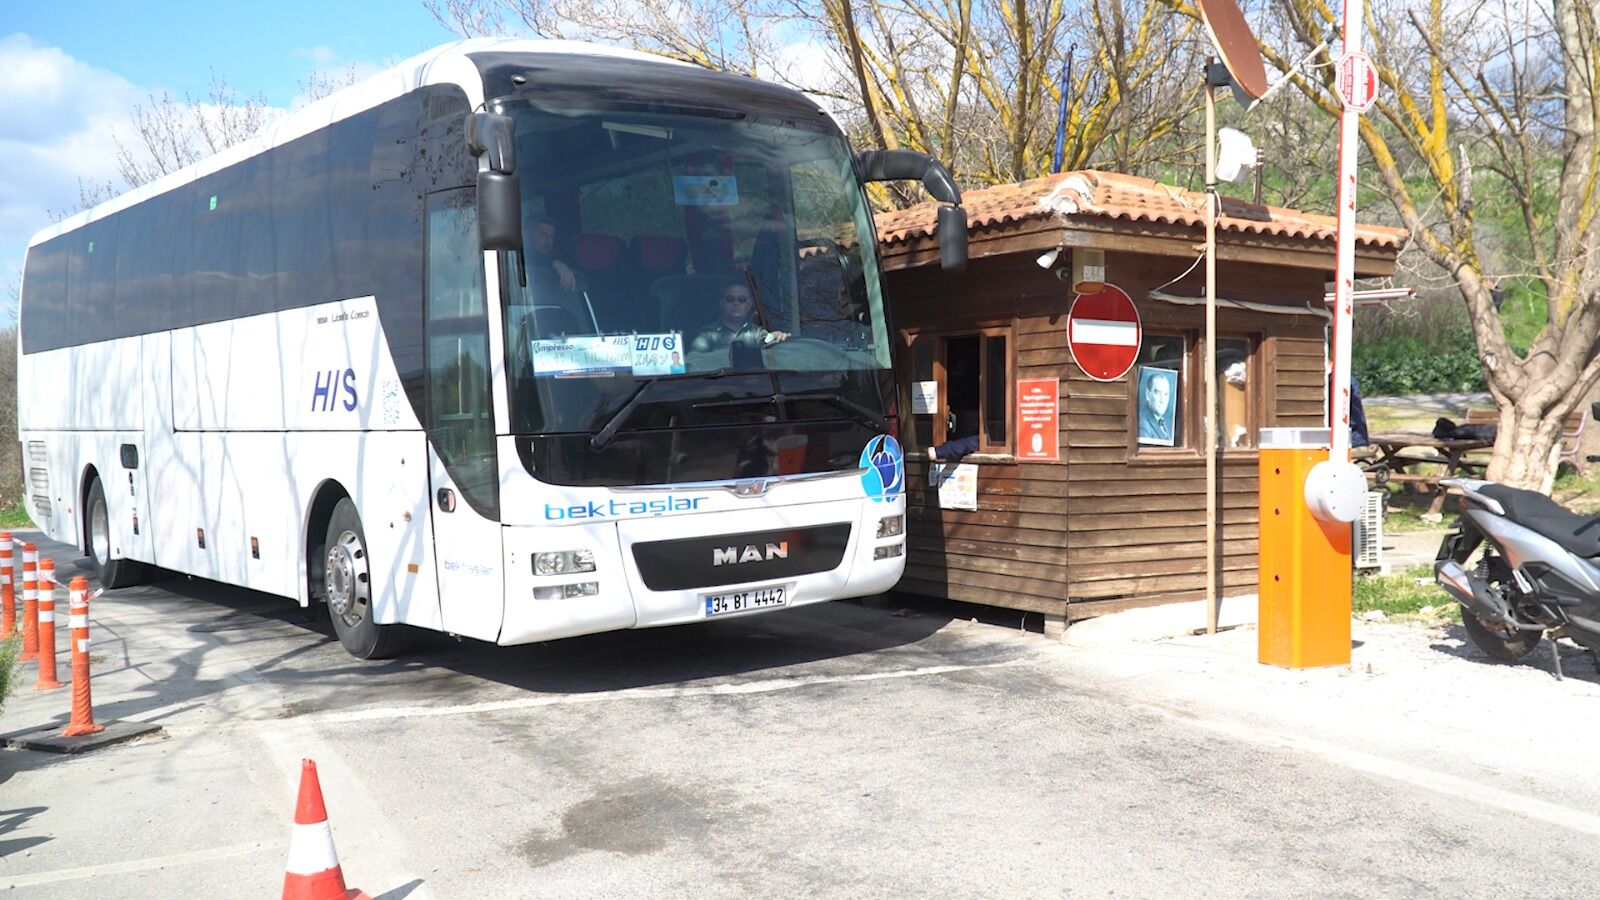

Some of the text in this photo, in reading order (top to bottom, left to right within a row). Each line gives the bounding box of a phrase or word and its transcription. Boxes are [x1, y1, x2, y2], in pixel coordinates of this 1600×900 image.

[636, 336, 676, 351] HIS
[311, 368, 358, 412] HIS
[544, 495, 710, 521] bektaşlar
[713, 541, 788, 566] MAN
[713, 597, 728, 613] 34
[734, 593, 748, 610] BT
[754, 588, 784, 606] 4442
